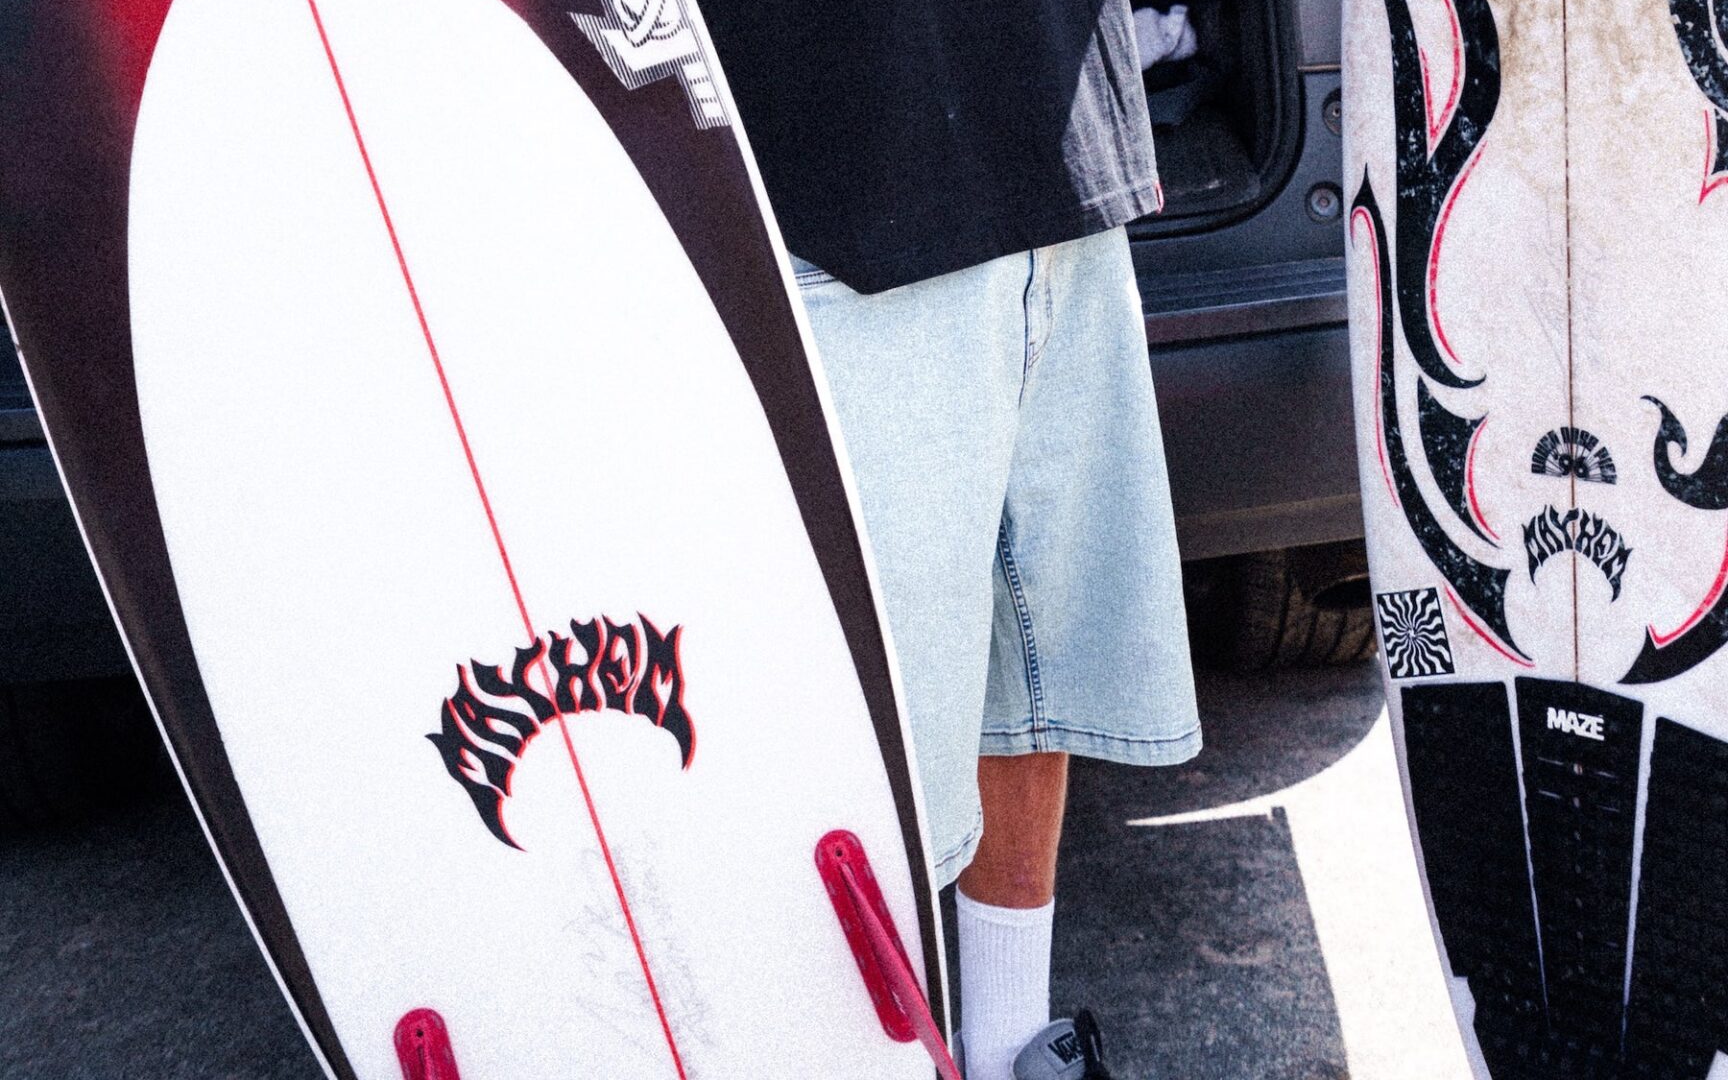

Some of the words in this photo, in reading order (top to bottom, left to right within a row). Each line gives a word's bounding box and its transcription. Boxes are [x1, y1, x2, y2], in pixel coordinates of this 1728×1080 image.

[1521, 504, 1634, 604] MAYHEM
[424, 610, 697, 853] MAYHEM
[1547, 706, 1605, 741] MAZE
